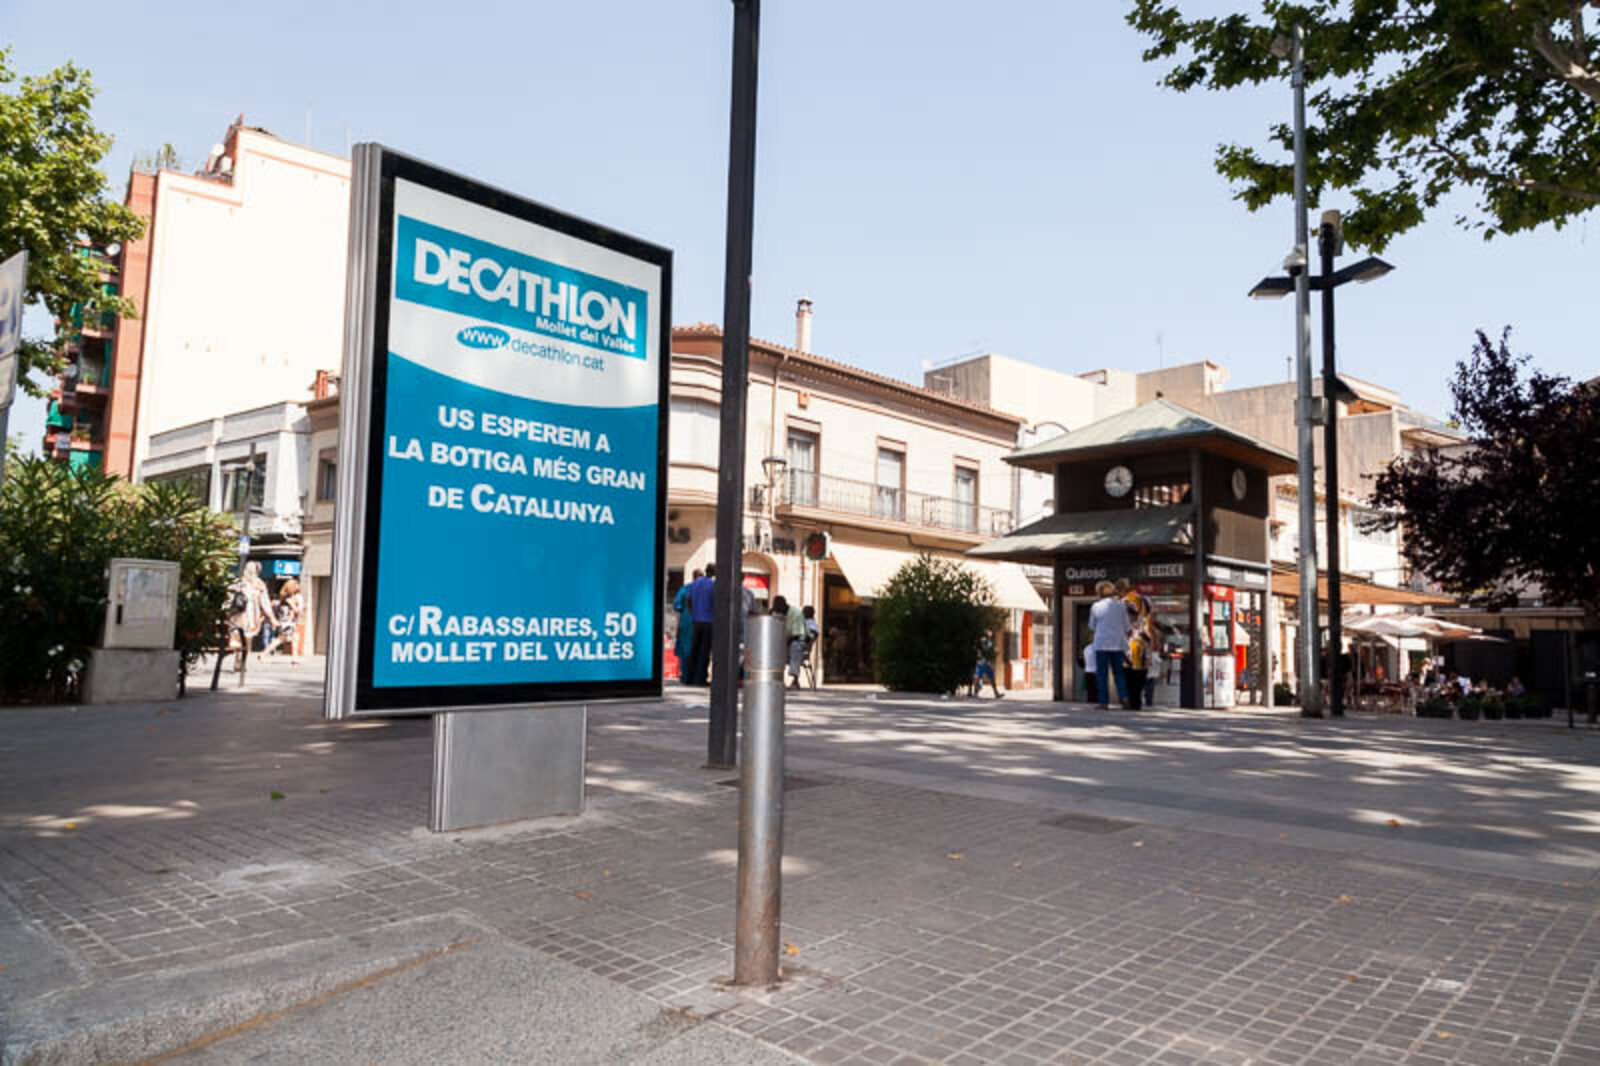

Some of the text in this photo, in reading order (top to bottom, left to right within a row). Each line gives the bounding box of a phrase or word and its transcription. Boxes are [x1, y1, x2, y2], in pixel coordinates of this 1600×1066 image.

[413, 237, 637, 339] DECATHLON
[535, 317, 577, 339] Mollet
[579, 327, 599, 343] del
[438, 405, 611, 453] US ESPEREM A
[388, 436, 646, 490] LA BOTIGA MÉS GRAN
[428, 485, 464, 510] DE
[604, 612, 637, 636] 50
[391, 642, 497, 663] MOLLET
[503, 642, 548, 661] DEL
